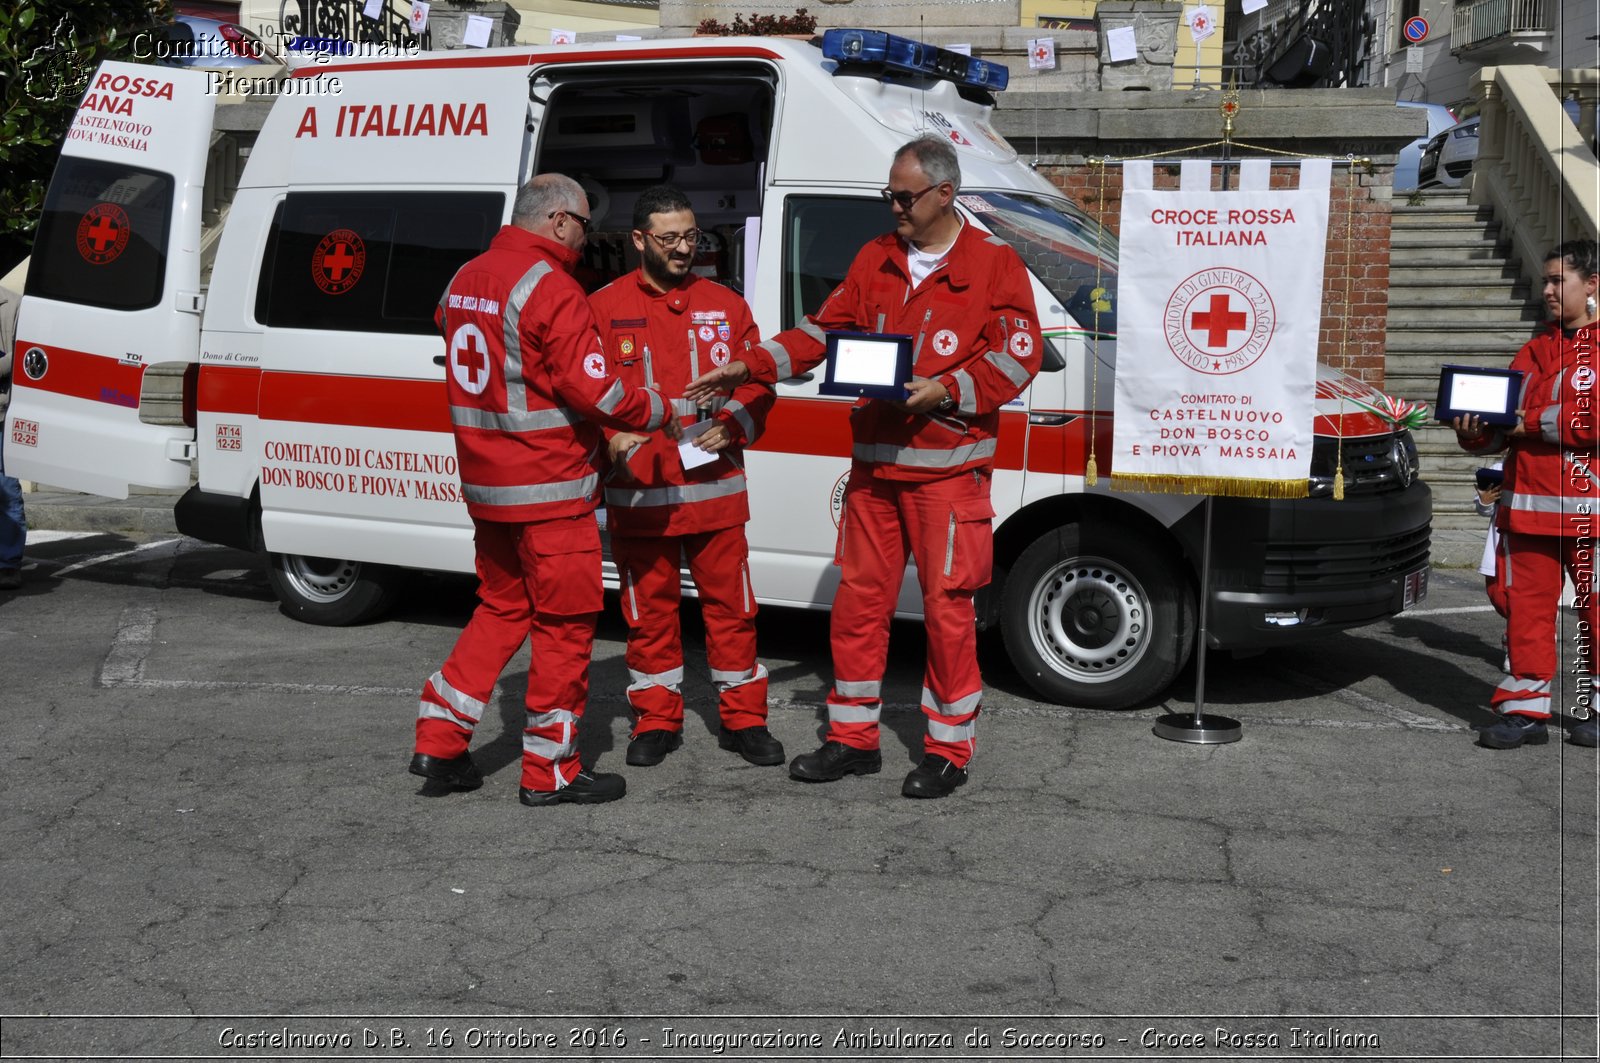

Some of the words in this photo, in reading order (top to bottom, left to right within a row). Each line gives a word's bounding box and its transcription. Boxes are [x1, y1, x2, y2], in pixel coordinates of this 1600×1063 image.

[259, 24, 274, 38] 10
[95, 72, 174, 101] ROSSA
[81, 93, 134, 117] ANA
[295, 106, 318, 138] A
[335, 103, 489, 138] ITALIANA
[98, 132, 148, 152] MASSAIA
[1151, 209, 1218, 226] CROCE
[1228, 208, 1296, 225] ROSSA
[1176, 230, 1268, 246] ITALIANA
[1182, 280, 1198, 297] DI
[1198, 270, 1253, 294] GINEVRA
[1250, 292, 1267, 308] 22
[1167, 293, 1210, 371] CONVENZIONE
[1246, 308, 1271, 355] AGOSTO
[126, 352, 143, 361] TDI
[202, 351, 223, 361] Dono
[224, 352, 233, 361] di
[234, 352, 259, 362] Corno
[1225, 351, 1249, 370] 1864
[1181, 394, 1236, 405] COMITATO
[1241, 395, 1252, 405] DI
[1150, 409, 1283, 424] CASTELNUOVO
[14, 420, 25, 431] AT
[26, 422, 37, 433] 14
[217, 426, 228, 436] AT
[230, 427, 241, 437] 14
[1160, 427, 1195, 439] DON
[1208, 428, 1270, 442] BOSCO
[12, 432, 37, 446] 12-25
[217, 438, 241, 450] 12-25
[264, 440, 342, 466] COMITATO
[345, 447, 361, 468] DI
[1132, 445, 1141, 456] E
[1219, 446, 1297, 460] MASSAIA
[262, 466, 292, 488] DON
[296, 469, 344, 492] BOSCO
[348, 474, 358, 494] E
[361, 475, 410, 498] PIOVA'
